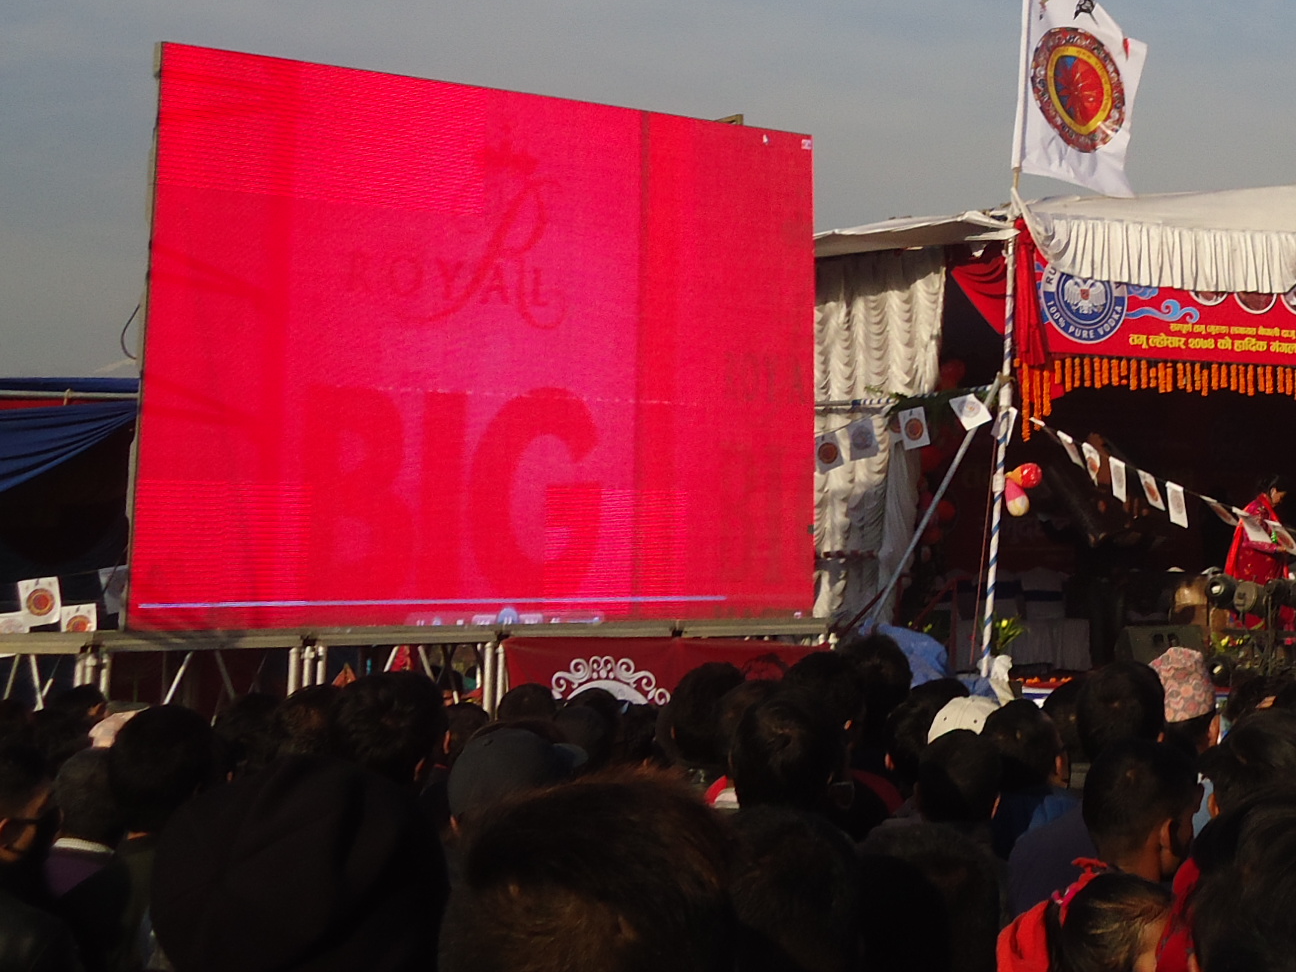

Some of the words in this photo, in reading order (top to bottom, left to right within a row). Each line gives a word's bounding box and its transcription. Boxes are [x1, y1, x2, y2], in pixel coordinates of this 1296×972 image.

[1046, 300, 1066, 328] 100%
[1068, 325, 1095, 339] PURE
[1097, 305, 1123, 336] VODKA
[1128, 333, 1149, 349] तमू
[1148, 333, 1187, 349] ल्होसार
[1188, 338, 1215, 349] २०७४
[1217, 335, 1233, 350] को
[1233, 336, 1268, 352] हार्दिक
[299, 382, 602, 598] BIG
